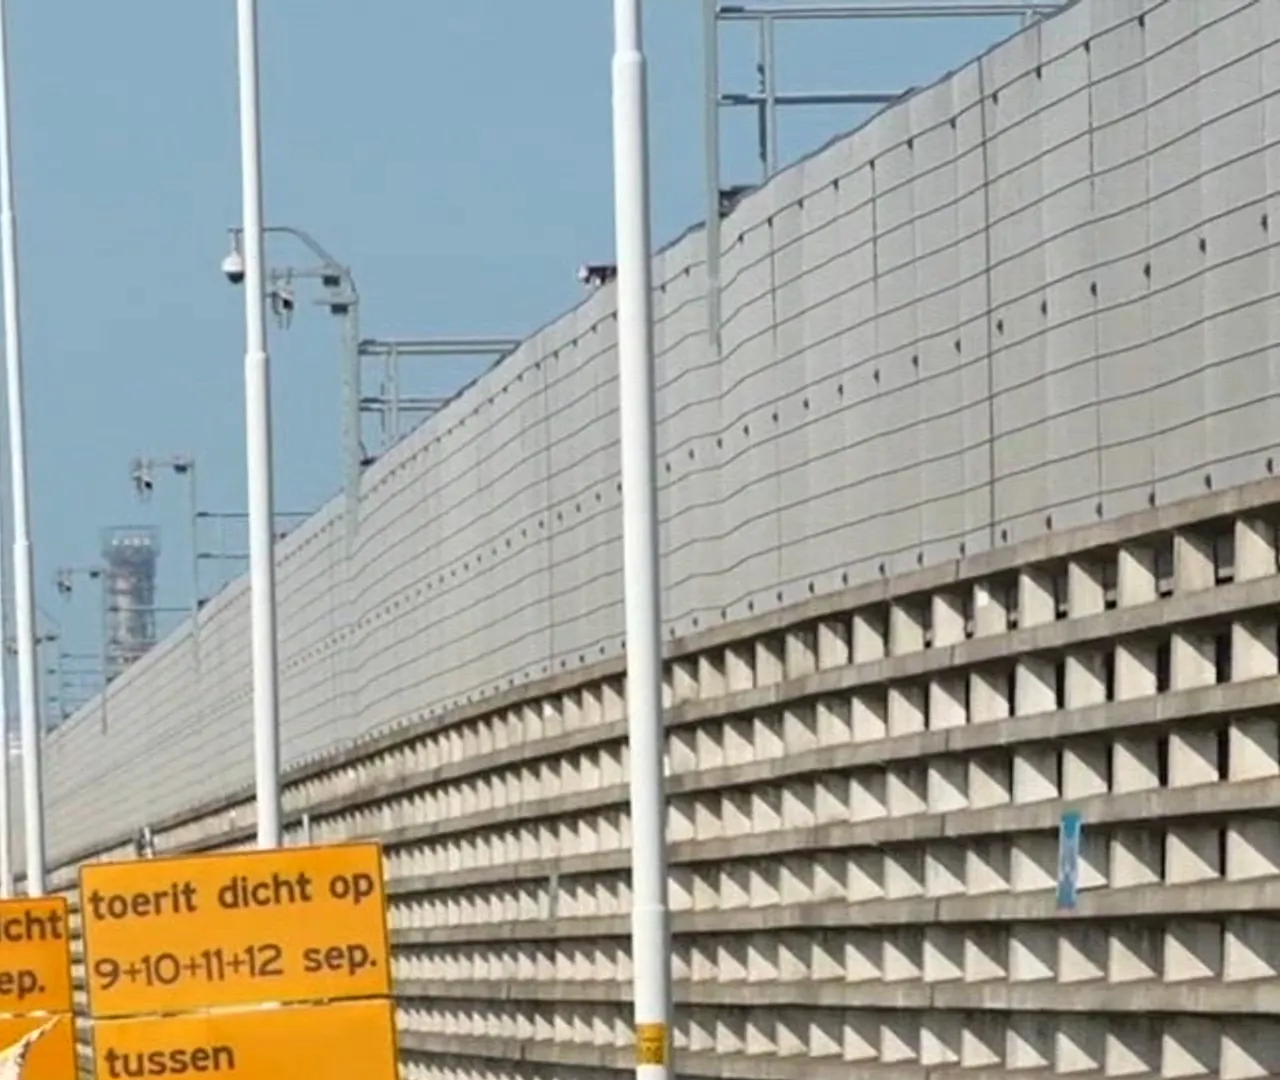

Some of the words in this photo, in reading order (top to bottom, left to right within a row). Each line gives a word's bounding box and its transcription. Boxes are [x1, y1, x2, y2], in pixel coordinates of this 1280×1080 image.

[89, 881, 197, 920] toerit
[217, 871, 312, 909] dicht
[329, 872, 374, 905] op
[93, 943, 284, 990] 9+10+11+12
[303, 944, 378, 975] sep.
[105, 1045, 235, 1078] tussen
